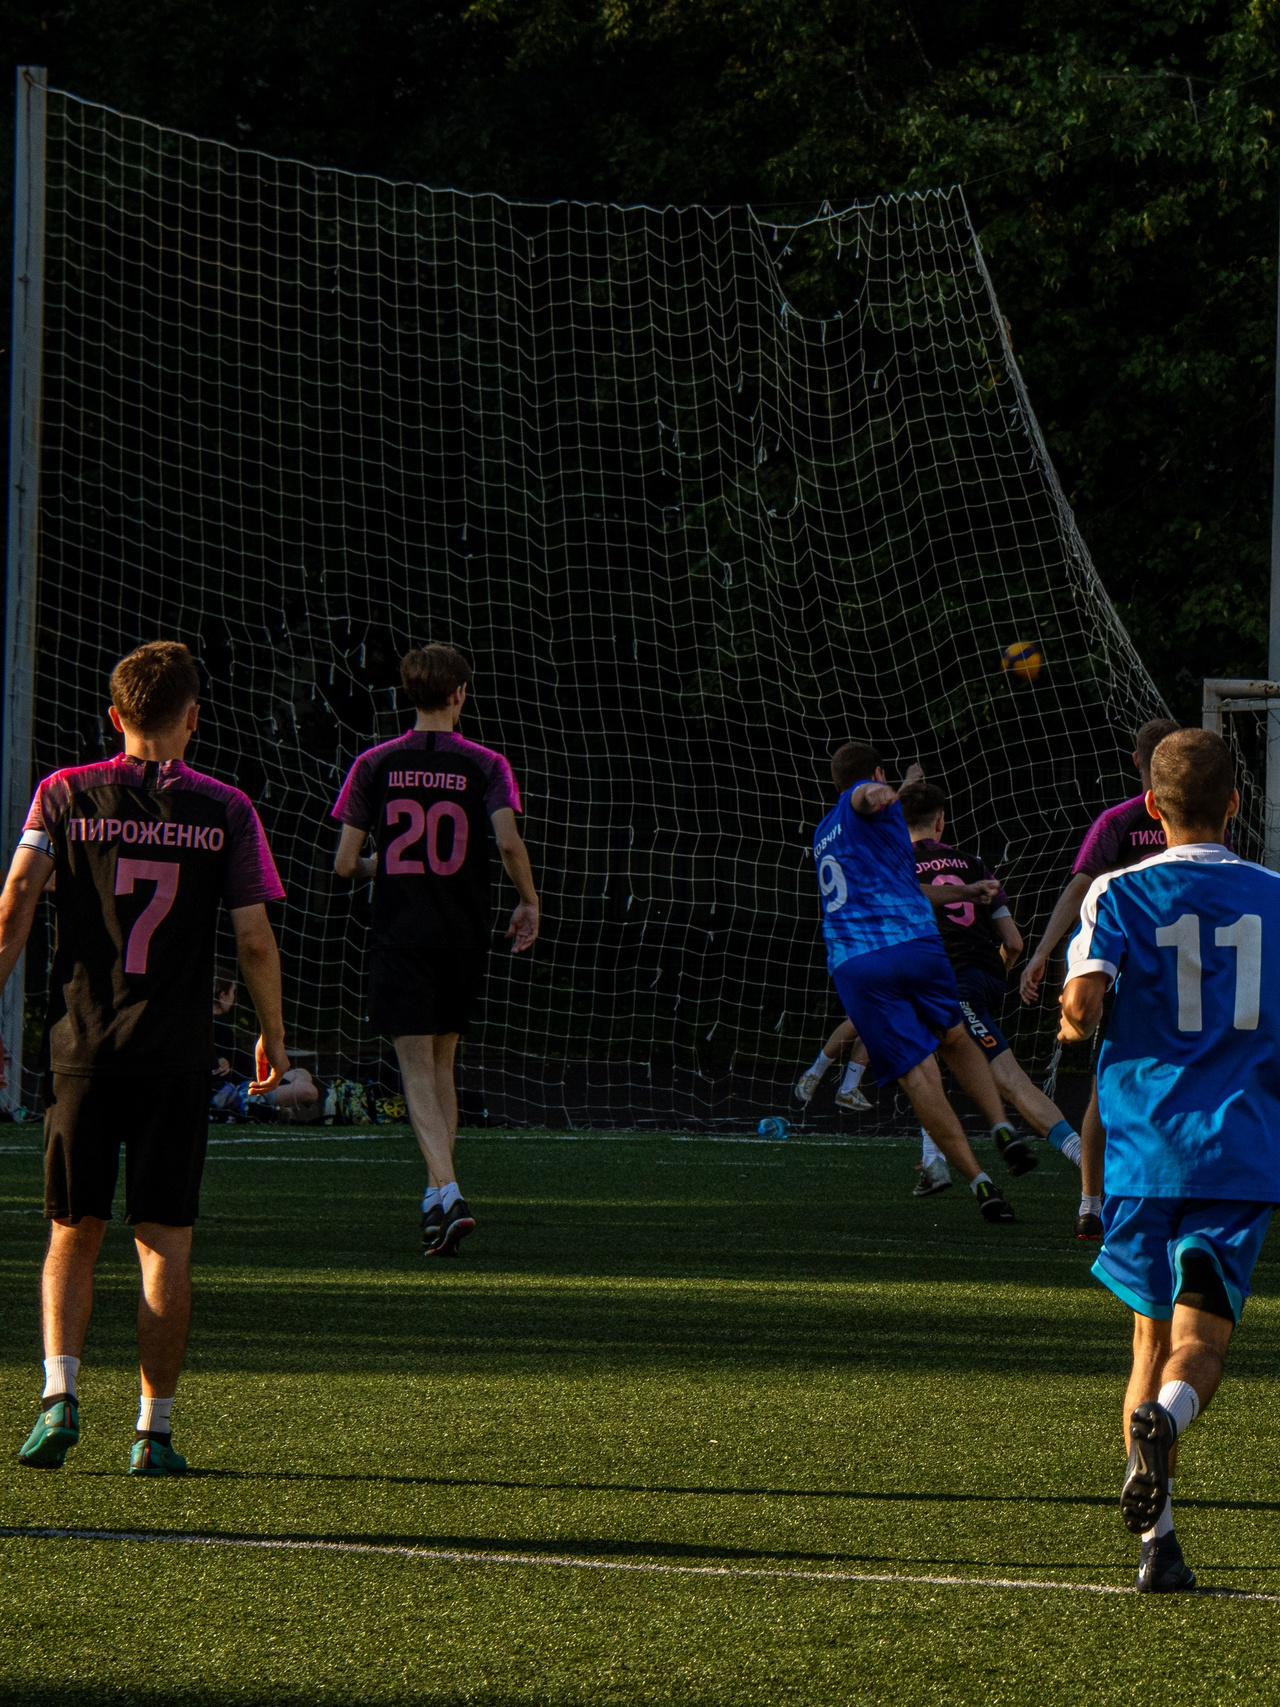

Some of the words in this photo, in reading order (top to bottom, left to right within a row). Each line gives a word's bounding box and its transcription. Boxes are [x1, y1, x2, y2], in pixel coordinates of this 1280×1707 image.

[388, 770, 468, 791] ЩЕГОЛЕВ
[69, 817, 225, 852] ПИРОЖЕНКО
[385, 798, 469, 876] 20
[819, 854, 848, 913] 9
[114, 857, 180, 975] 7
[1155, 913, 1262, 1032] 11
[959, 1001, 998, 1048] G-DRIVE
